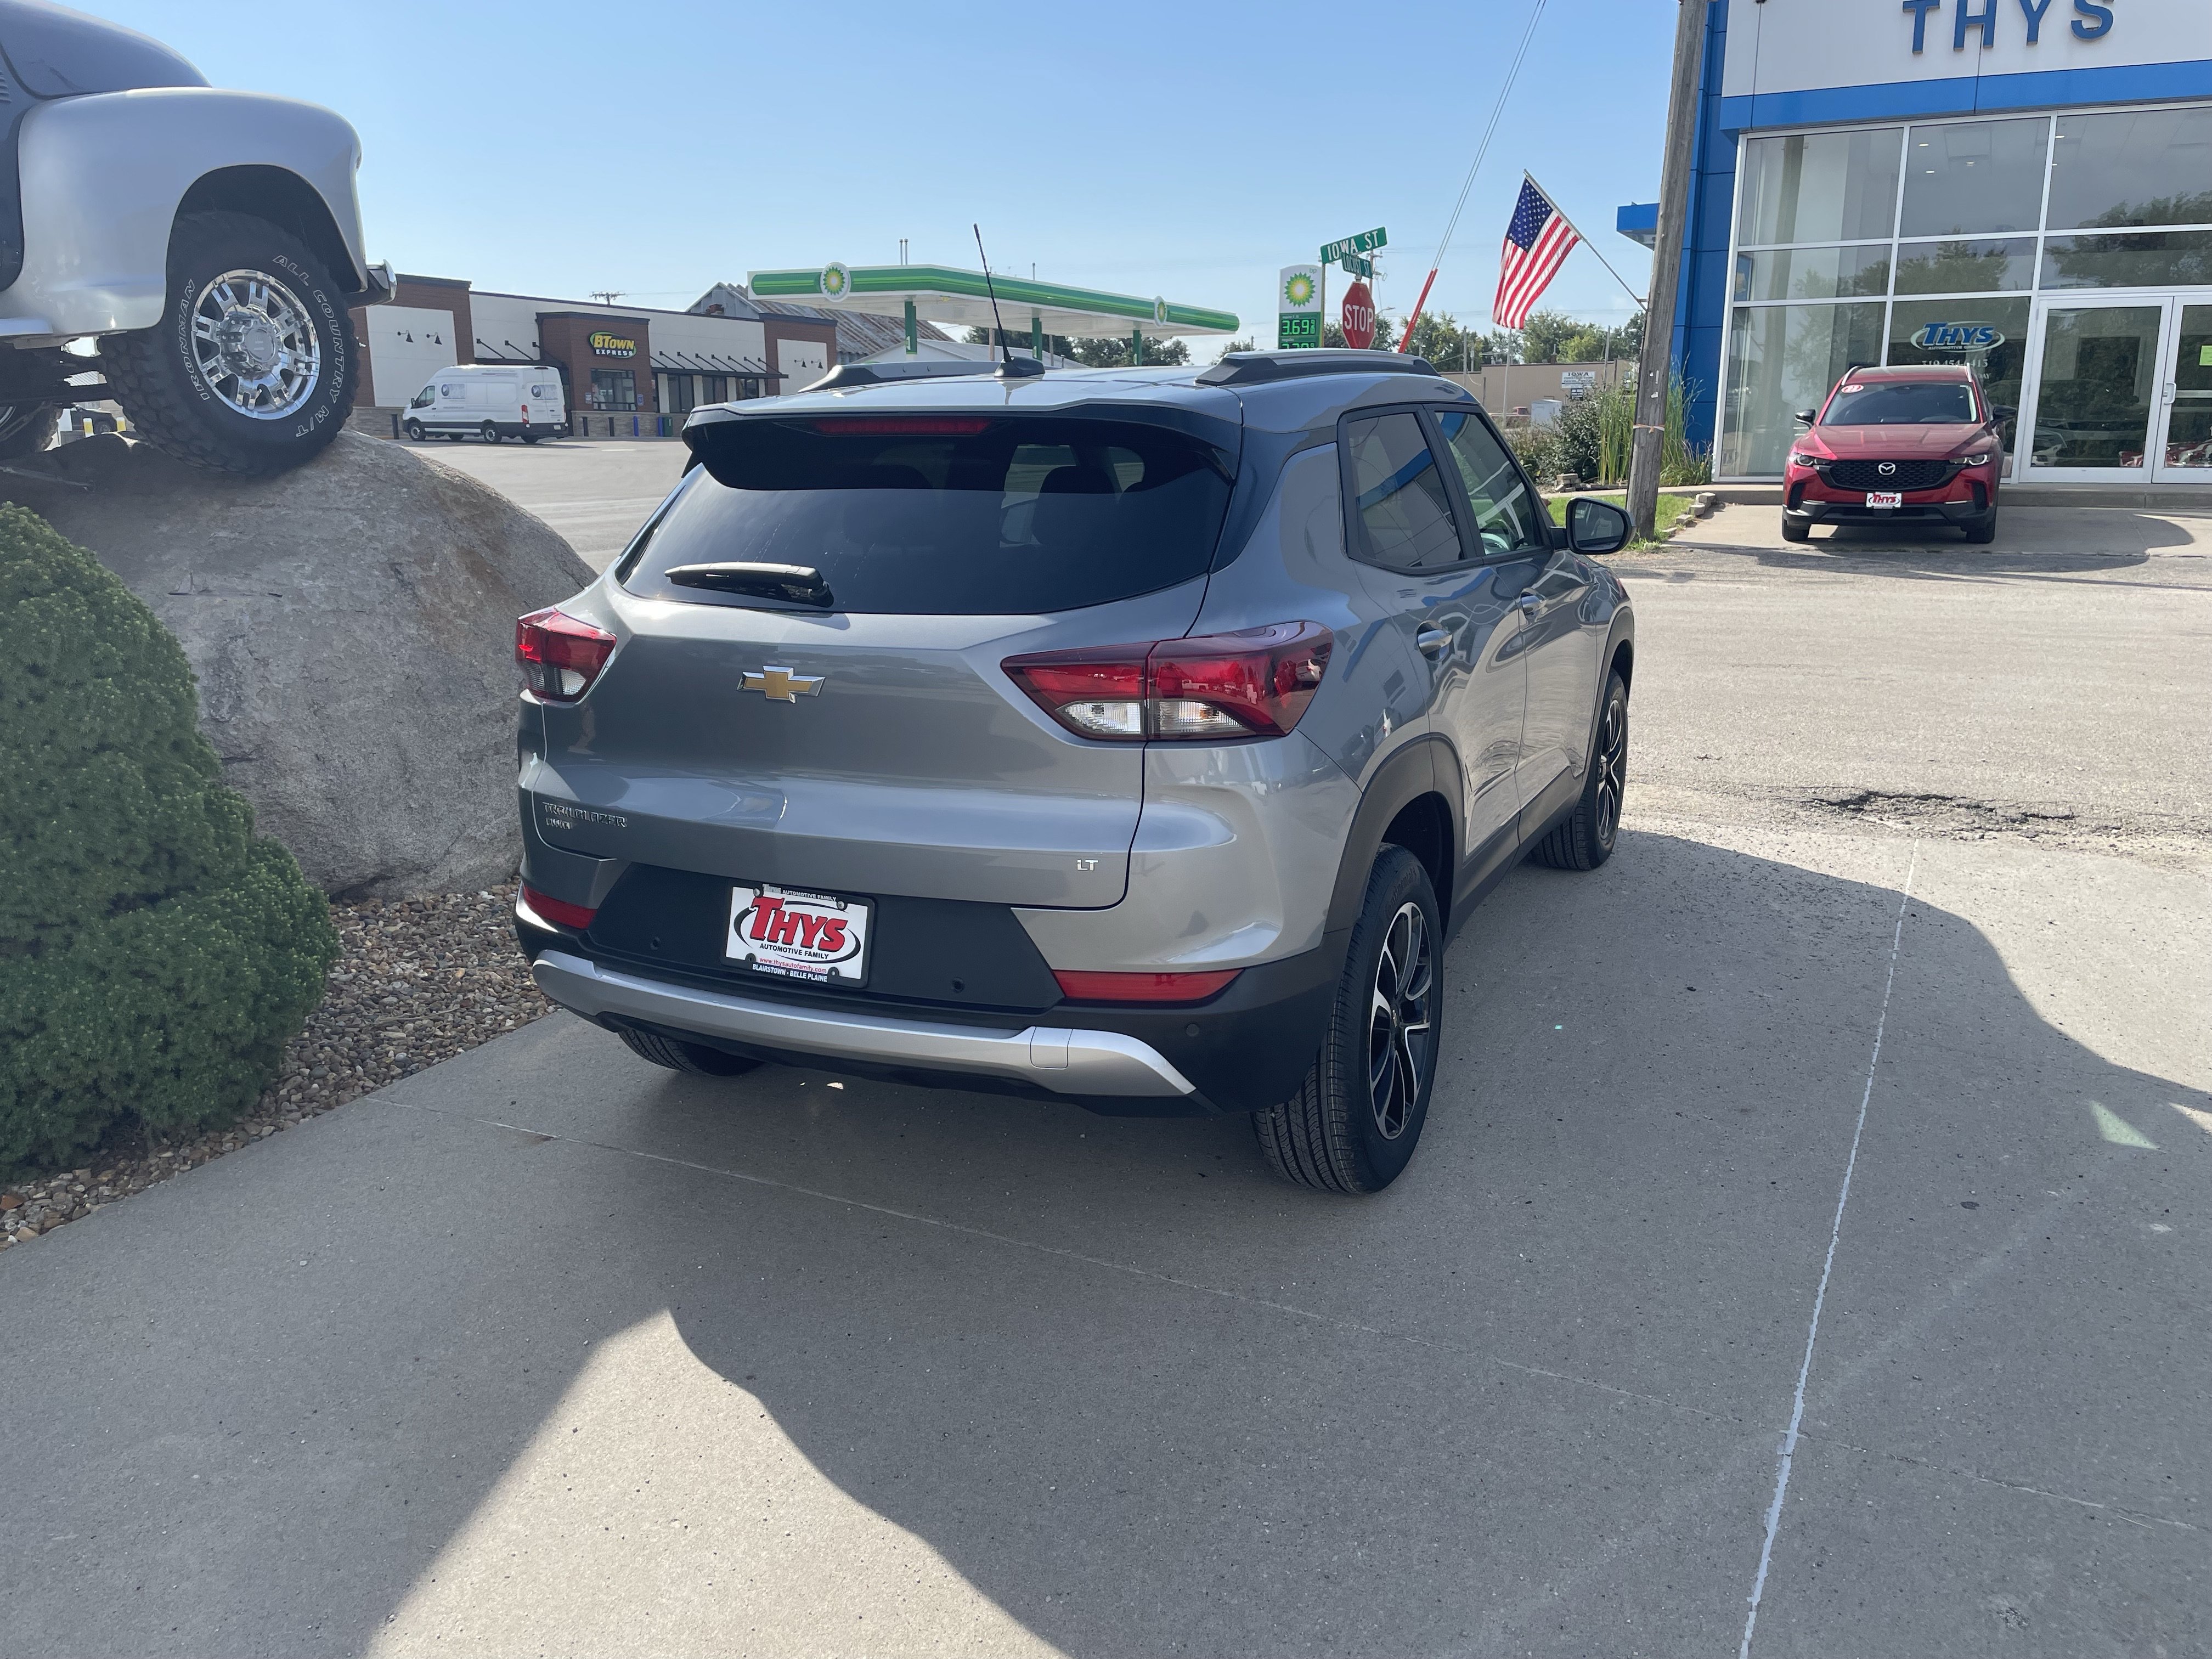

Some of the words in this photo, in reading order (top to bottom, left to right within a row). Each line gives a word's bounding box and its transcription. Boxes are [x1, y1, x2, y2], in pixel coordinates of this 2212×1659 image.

[1902, 0, 2114, 54] THYS
[1327, 238, 1358, 261] IOWA
[1364, 230, 1379, 250] ST
[273, 255, 309, 286] ALL
[1342, 253, 1362, 274] LOCUST
[1363, 261, 1370, 277] ST
[1344, 304, 1374, 333] STOP
[177, 279, 210, 401] IRONMAN
[313, 289, 346, 404] COUNTRY
[296, 405, 330, 437] M/T
[542, 802, 628, 828] TRAILBLAZER
[1077, 859, 1099, 871] LT
[782, 889, 816, 899] AUTOMOTIVE
[759, 943, 803, 956] AUTOMOTIVE
[804, 950, 829, 960] FAMILY
[752, 963, 786, 975] BLAIRSTOWN
[789, 970, 807, 979] BELLE
[808, 973, 828, 983] PLAINE
[759, 957, 827, 974] www.thysautofamily.com
